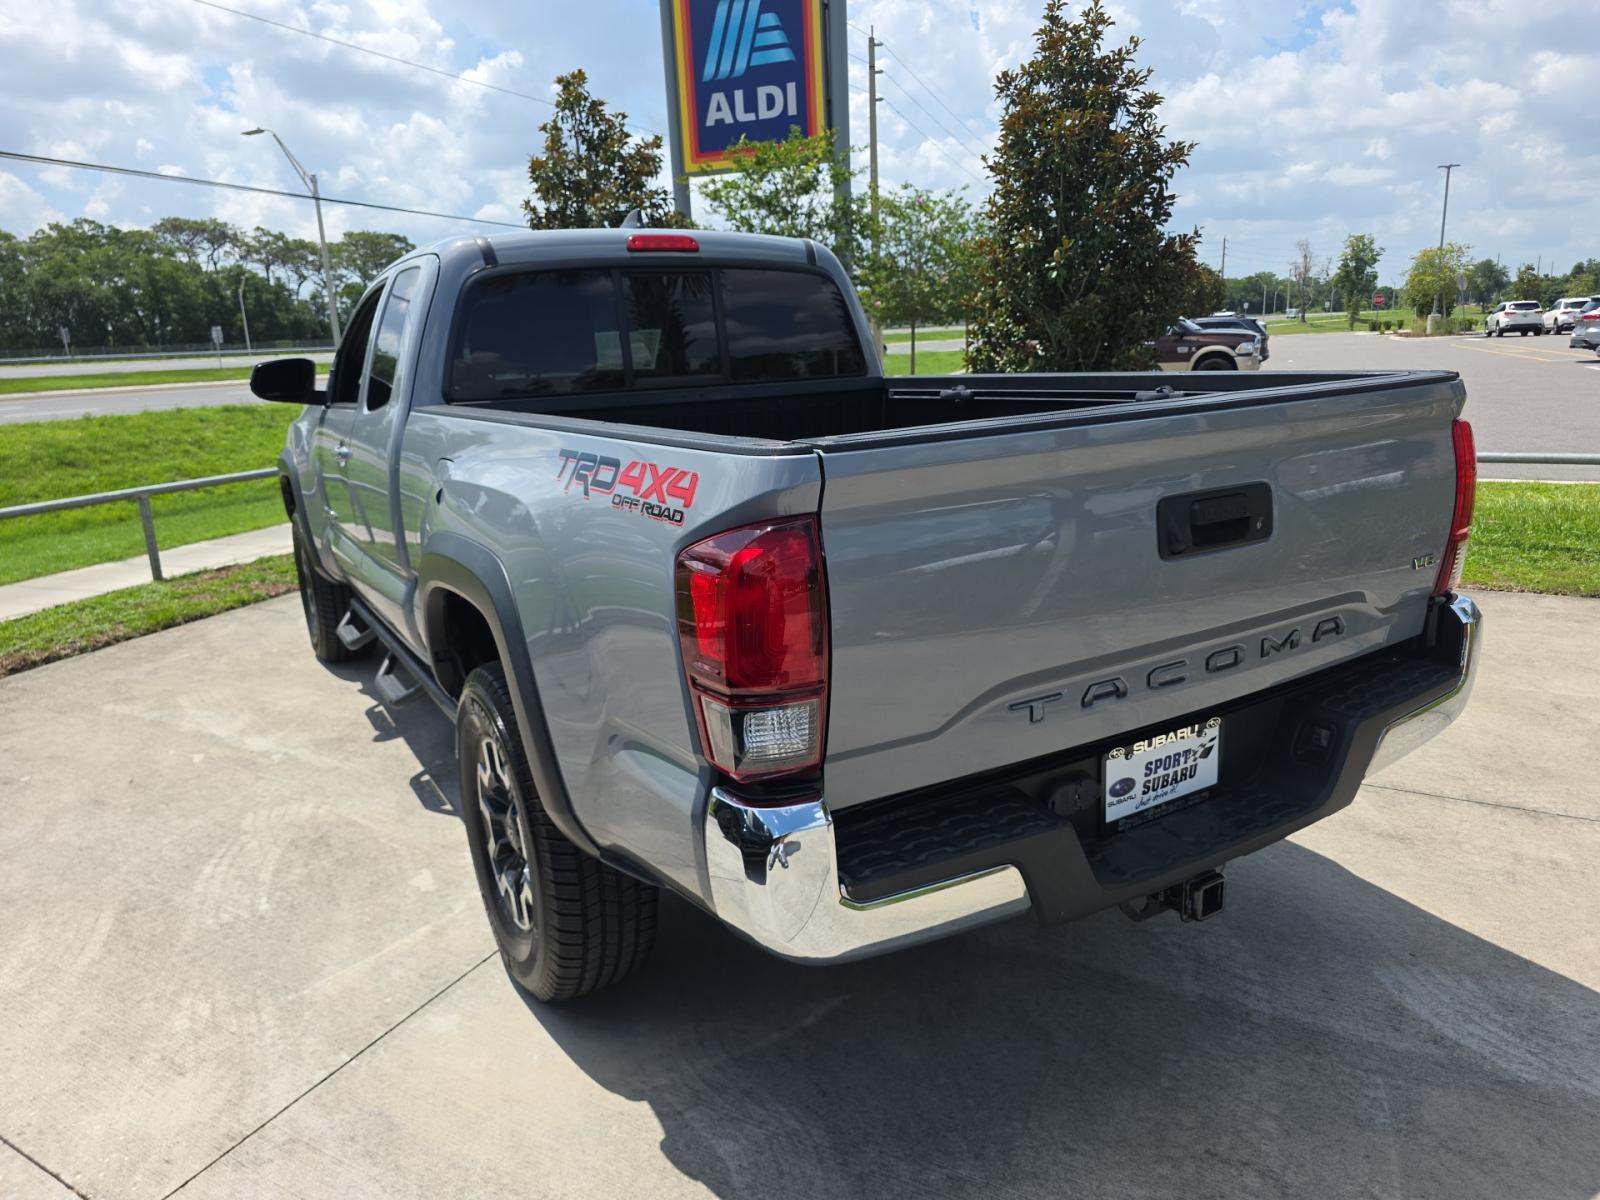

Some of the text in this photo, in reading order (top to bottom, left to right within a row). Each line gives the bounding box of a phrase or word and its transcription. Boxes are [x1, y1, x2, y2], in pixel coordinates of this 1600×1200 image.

[705, 82, 797, 127] ALDI
[556, 449, 621, 500] TRD
[611, 493, 685, 527] OFF ROAD
[1007, 615, 1347, 724] TACOMA
[1133, 724, 1199, 754] SUBARU
[1142, 763, 1198, 795] SUBARU
[1144, 748, 1192, 777] SPORT
[1107, 794, 1136, 808] SUBARU
